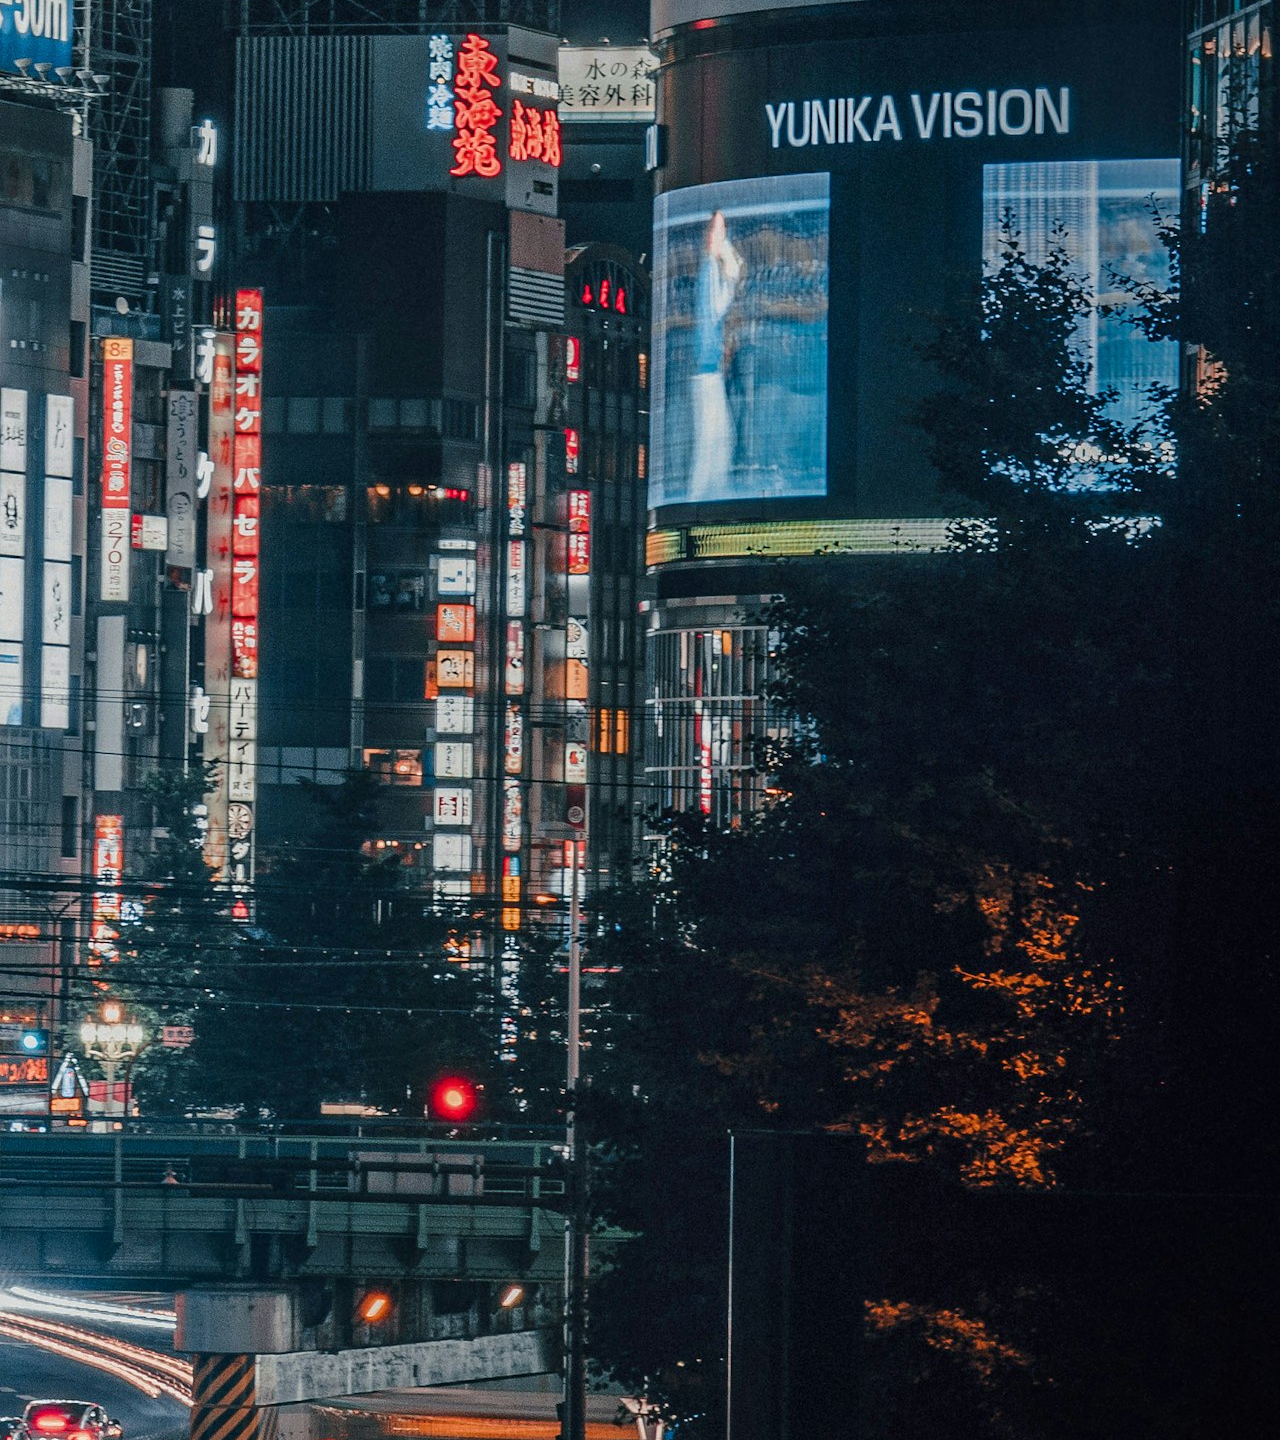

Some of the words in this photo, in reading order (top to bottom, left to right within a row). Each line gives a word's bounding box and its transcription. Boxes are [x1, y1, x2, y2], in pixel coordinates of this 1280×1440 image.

[450, 33, 503, 176] 東海苑
[558, 84, 653, 107] 美容外科
[765, 94, 902, 148] YUNIKA
[912, 86, 1070, 140] VISION
[109, 342, 128, 358] 8F
[236, 305, 261, 433] カラオケ
[233, 466, 260, 585] パセラ
